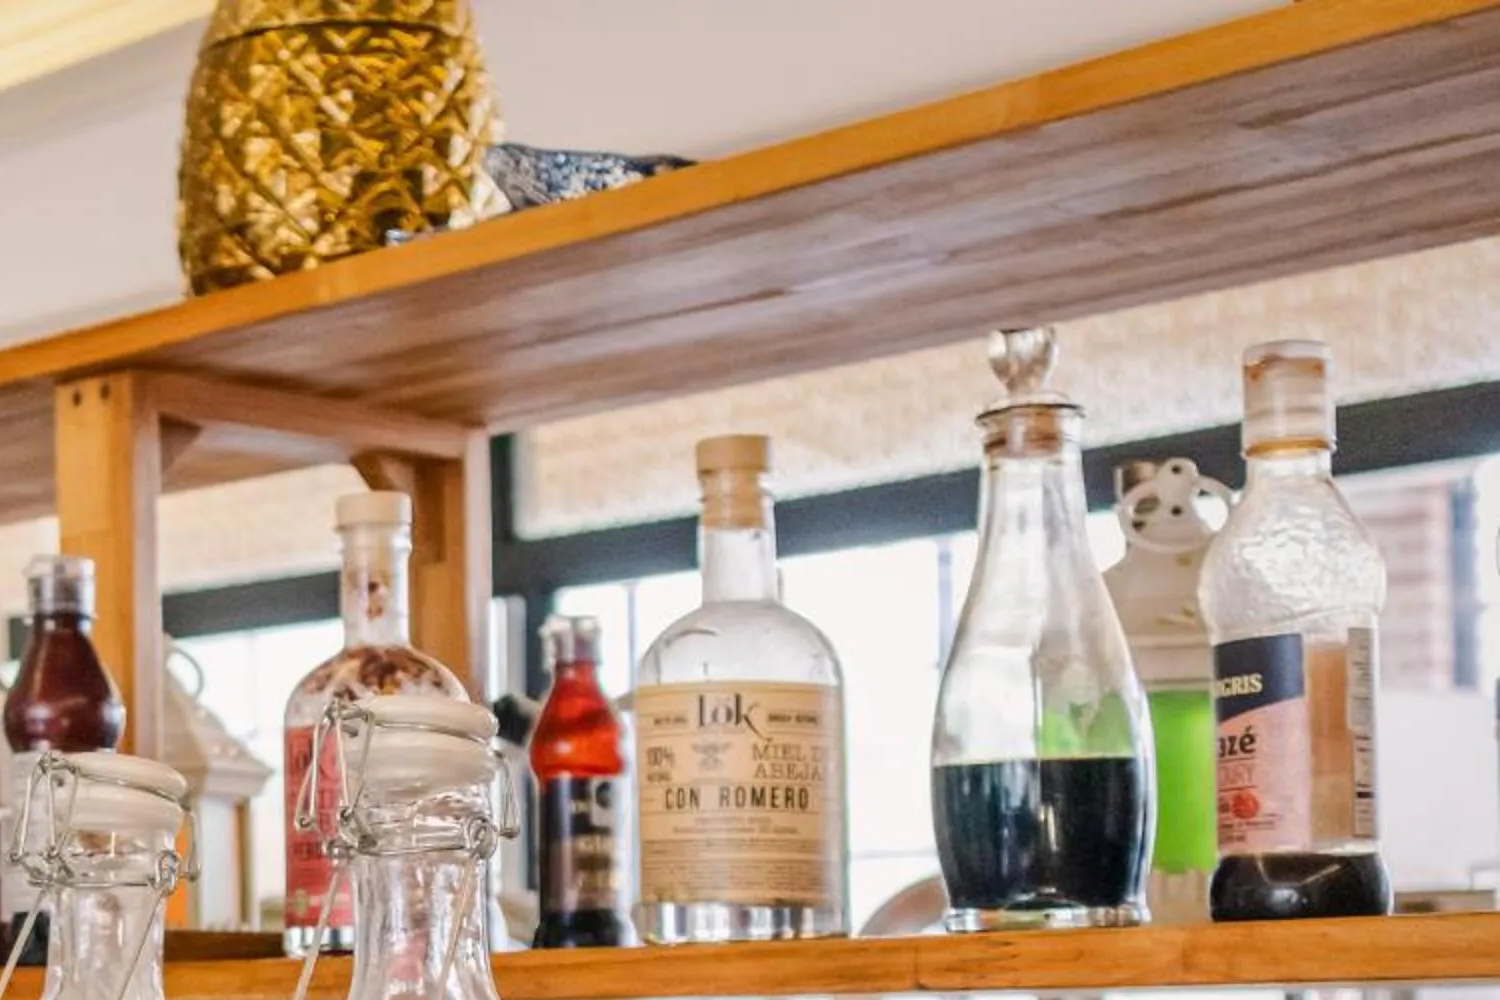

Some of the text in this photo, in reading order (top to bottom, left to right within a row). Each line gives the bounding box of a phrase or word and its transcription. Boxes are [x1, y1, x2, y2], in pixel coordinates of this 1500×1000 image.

[752, 743, 807, 762] MIEL
[665, 786, 810, 810] CON ROMERO
